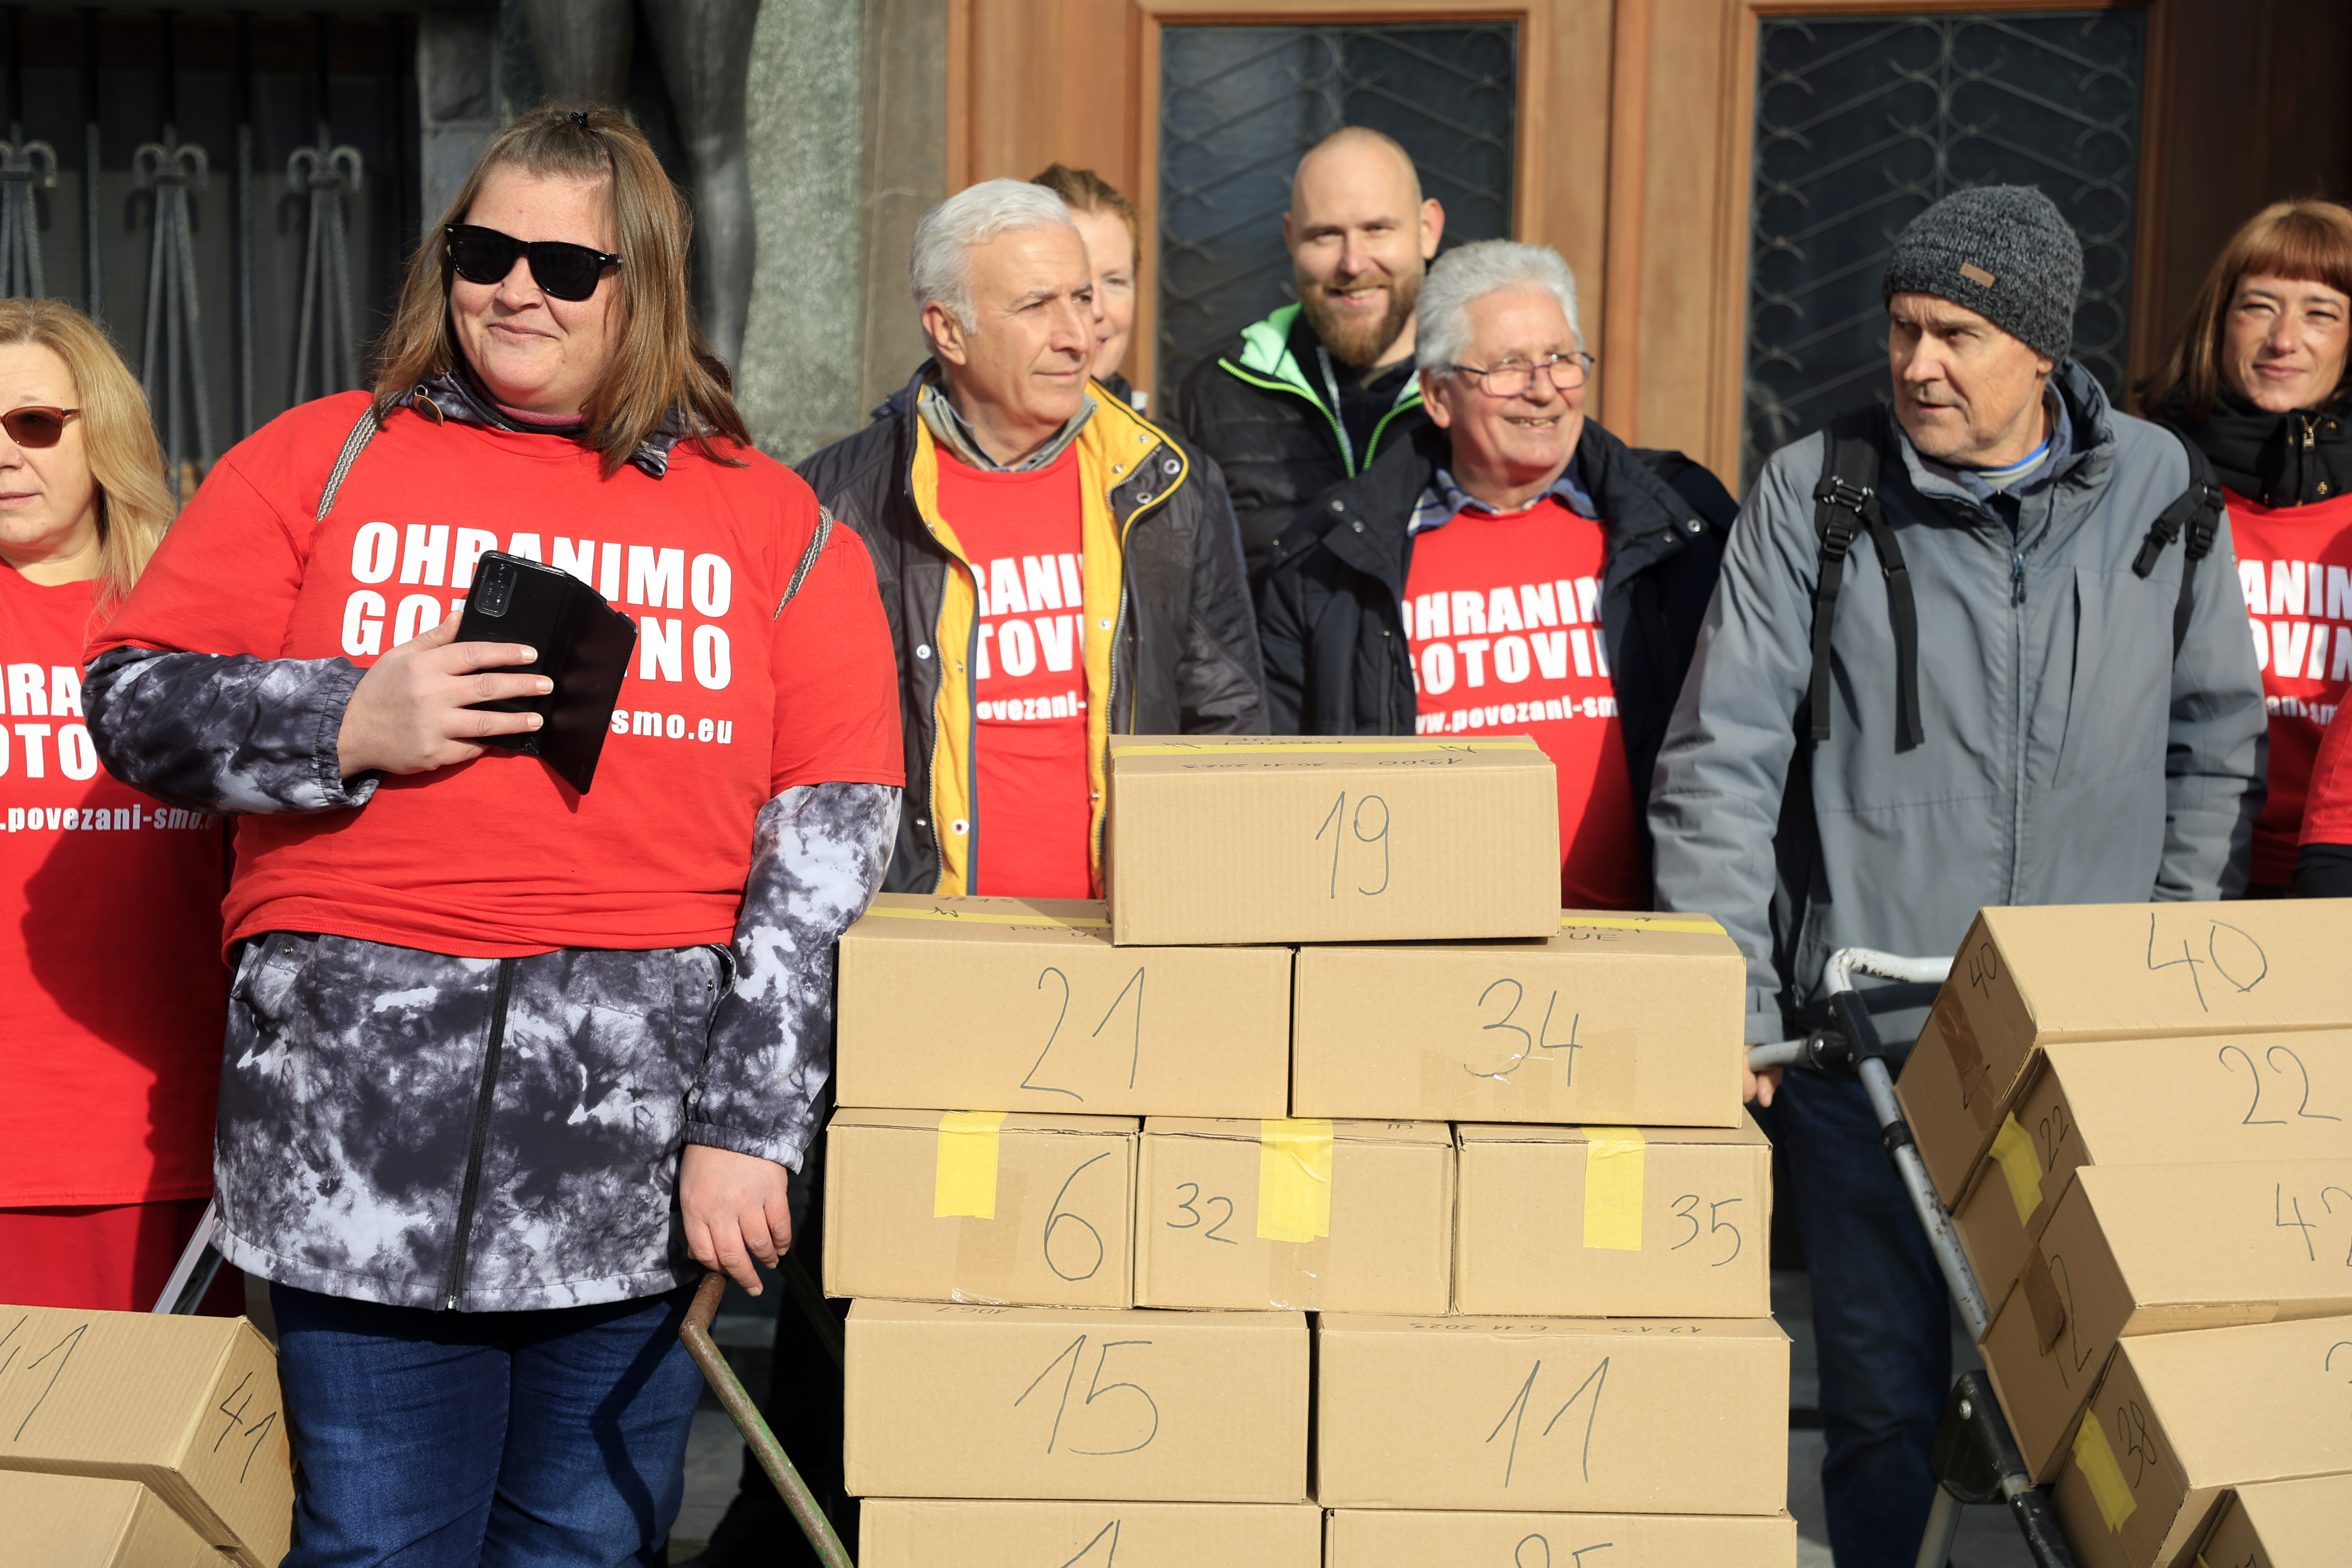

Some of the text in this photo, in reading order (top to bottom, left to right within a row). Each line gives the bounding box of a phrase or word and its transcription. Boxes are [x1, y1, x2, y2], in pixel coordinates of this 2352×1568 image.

[969, 553, 1083, 617] ANI
[0, 662, 84, 717] RA
[976, 613, 1086, 680] TOV
[0, 723, 98, 781] TO
[1315, 790, 1390, 900] 19
[1969, 942, 1997, 999] 40
[2148, 912, 2268, 1013] 40
[1020, 965, 1145, 1103] 21
[1463, 978, 1583, 1087] 34
[2219, 1045, 2342, 1125] 22
[2039, 1105, 2069, 1172] 22
[1044, 1151, 1111, 1281] 6
[1166, 1181, 1239, 1245] 32
[1670, 1194, 1743, 1268] 35
[0, 1315, 88, 1442] 1
[1014, 1334, 1159, 1455] 15
[1486, 1356, 1610, 1488] 11
[214, 1372, 277, 1484] 41
[2118, 1399, 2156, 1489] 38
